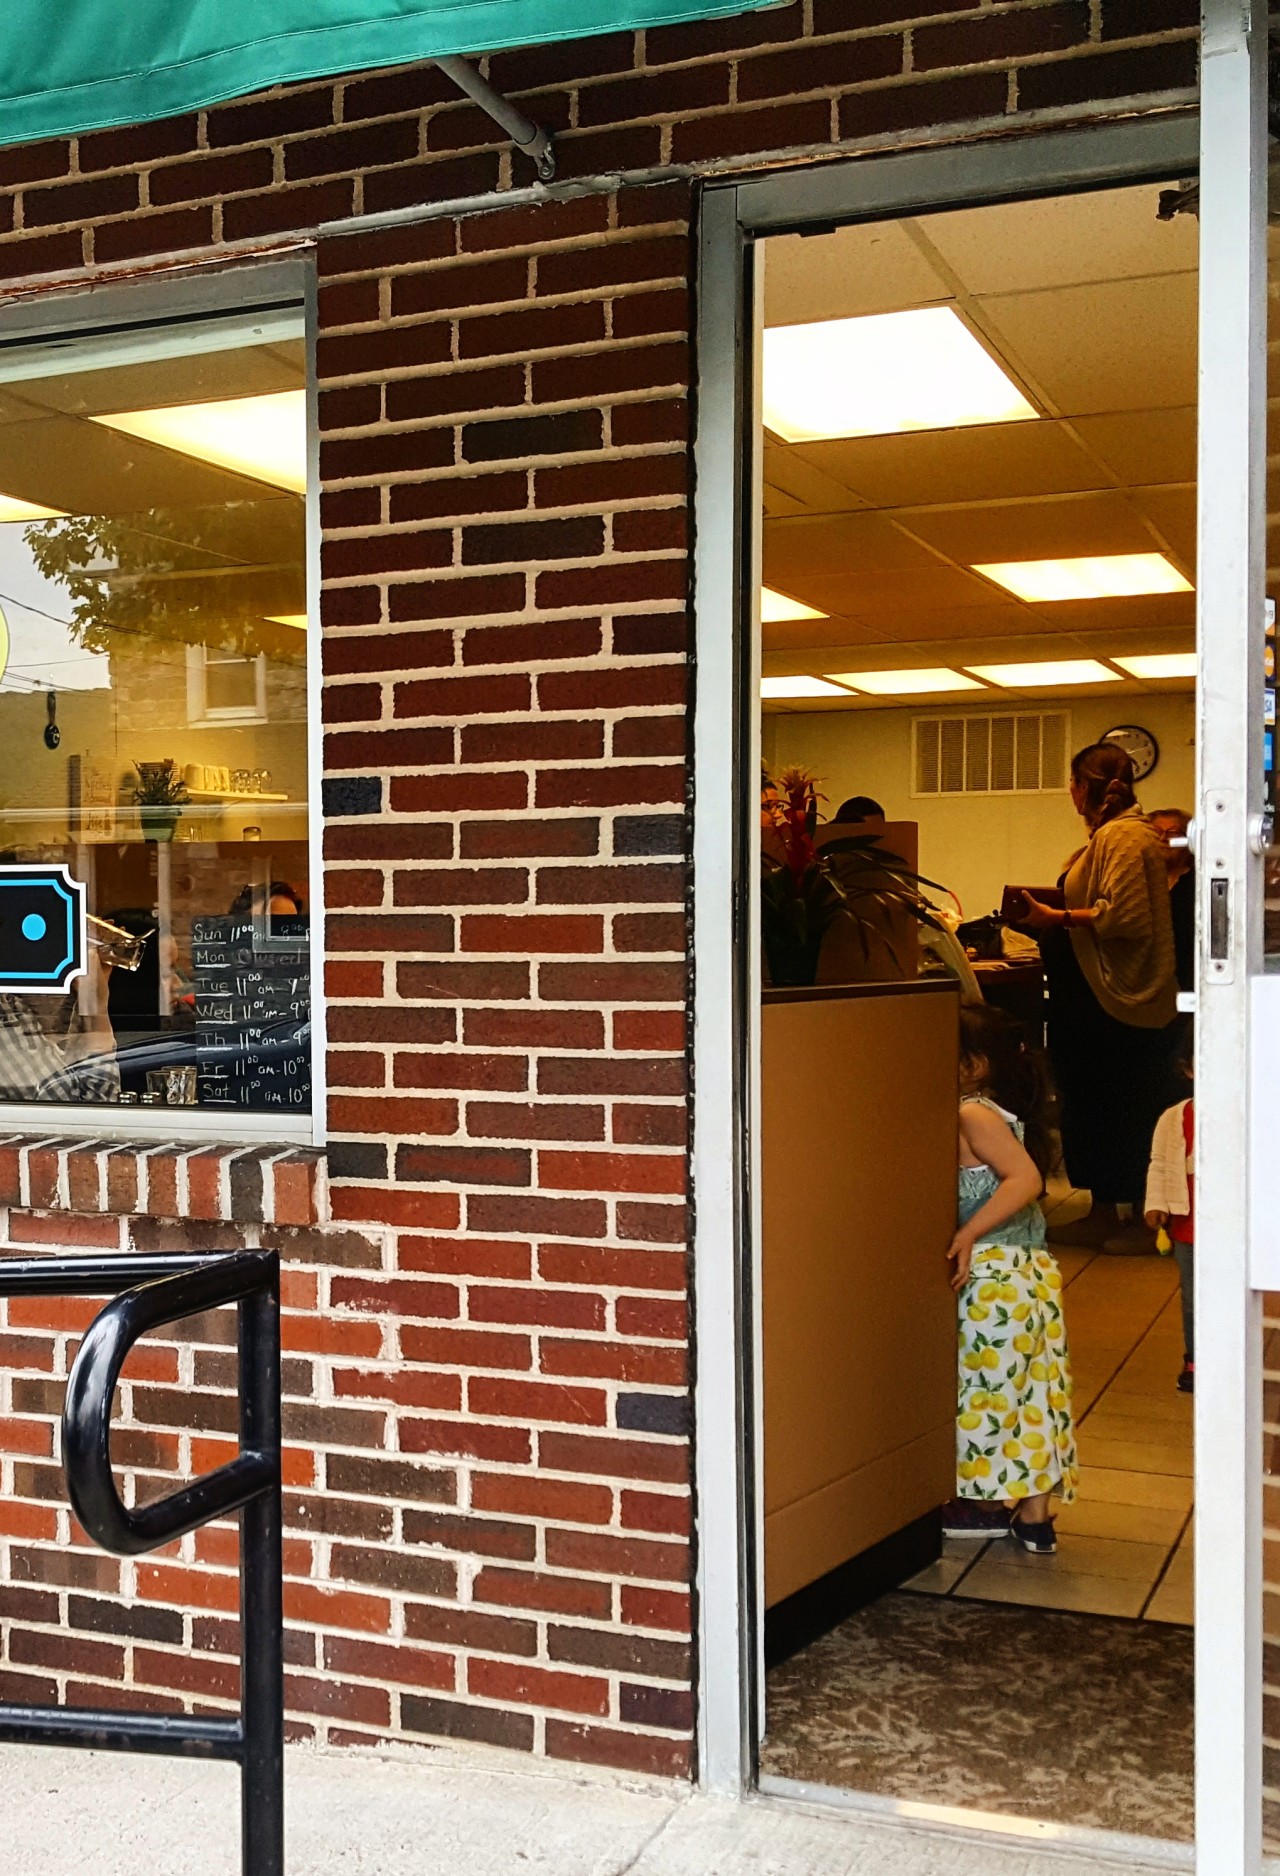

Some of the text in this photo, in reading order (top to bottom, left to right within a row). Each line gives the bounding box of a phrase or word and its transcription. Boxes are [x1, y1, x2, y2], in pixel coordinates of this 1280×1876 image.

[193, 923, 222, 942] Sun
[196, 949, 225, 963] Mon
[196, 977, 229, 993] Tue
[196, 1001, 233, 1022] Wed
[201, 1031, 226, 1047] Th
[201, 1061, 225, 1075] Fr
[202, 1083, 230, 1099] Sat
